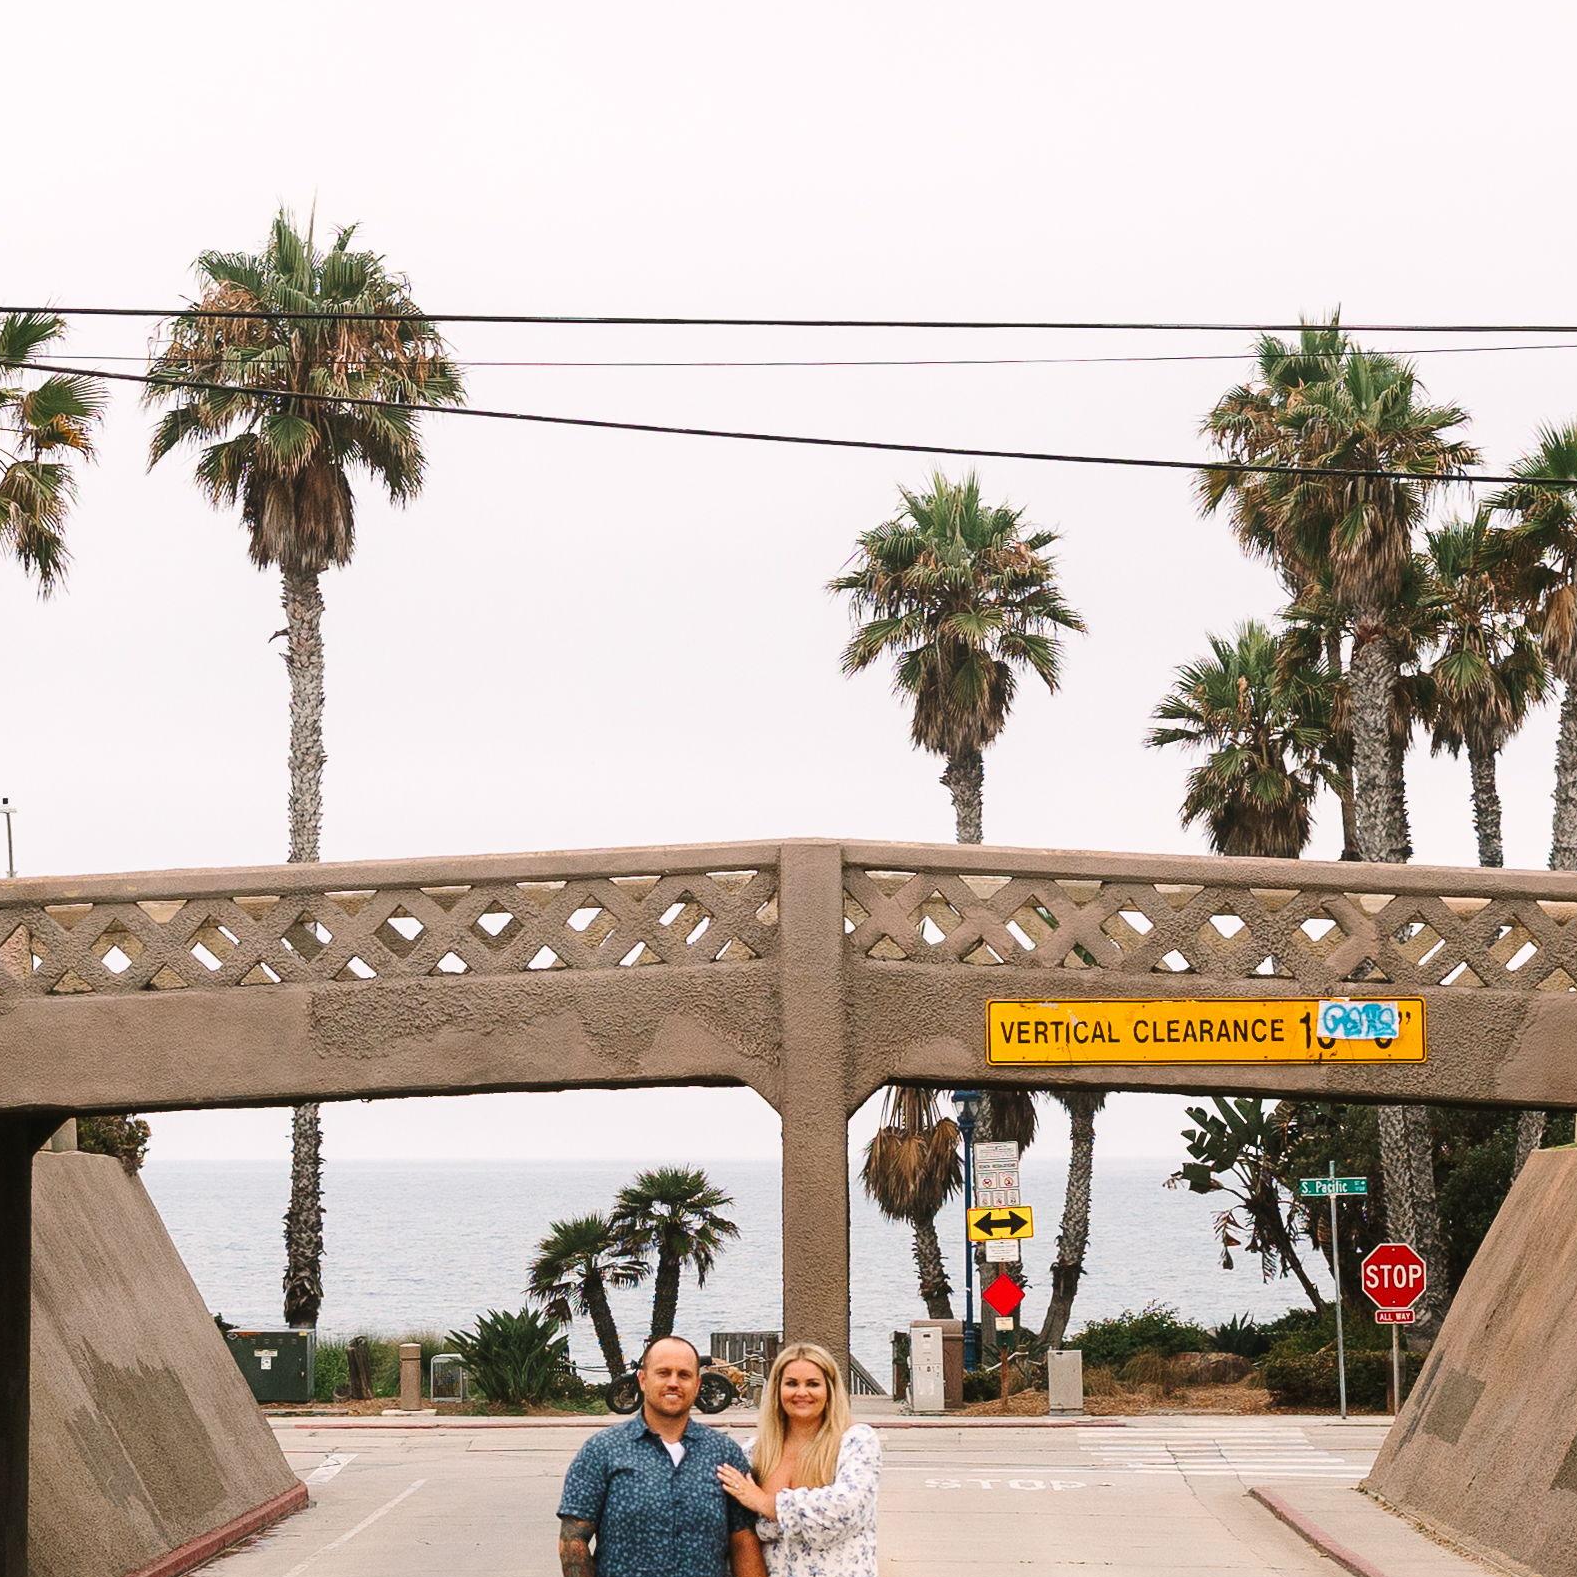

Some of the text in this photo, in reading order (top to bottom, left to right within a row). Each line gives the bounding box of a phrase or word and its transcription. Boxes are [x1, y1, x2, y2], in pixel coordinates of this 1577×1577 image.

[1000, 1021, 1120, 1044] VERTICAL
[1133, 1019, 1284, 1043] CLEARANCE
[1301, 1181, 1312, 1194] S.
[1315, 1180, 1348, 1193] Pacific
[1365, 1264, 1423, 1289] STOP
[1379, 1311, 1411, 1321] ALL WAY
[924, 1478, 1088, 1491] STOP
